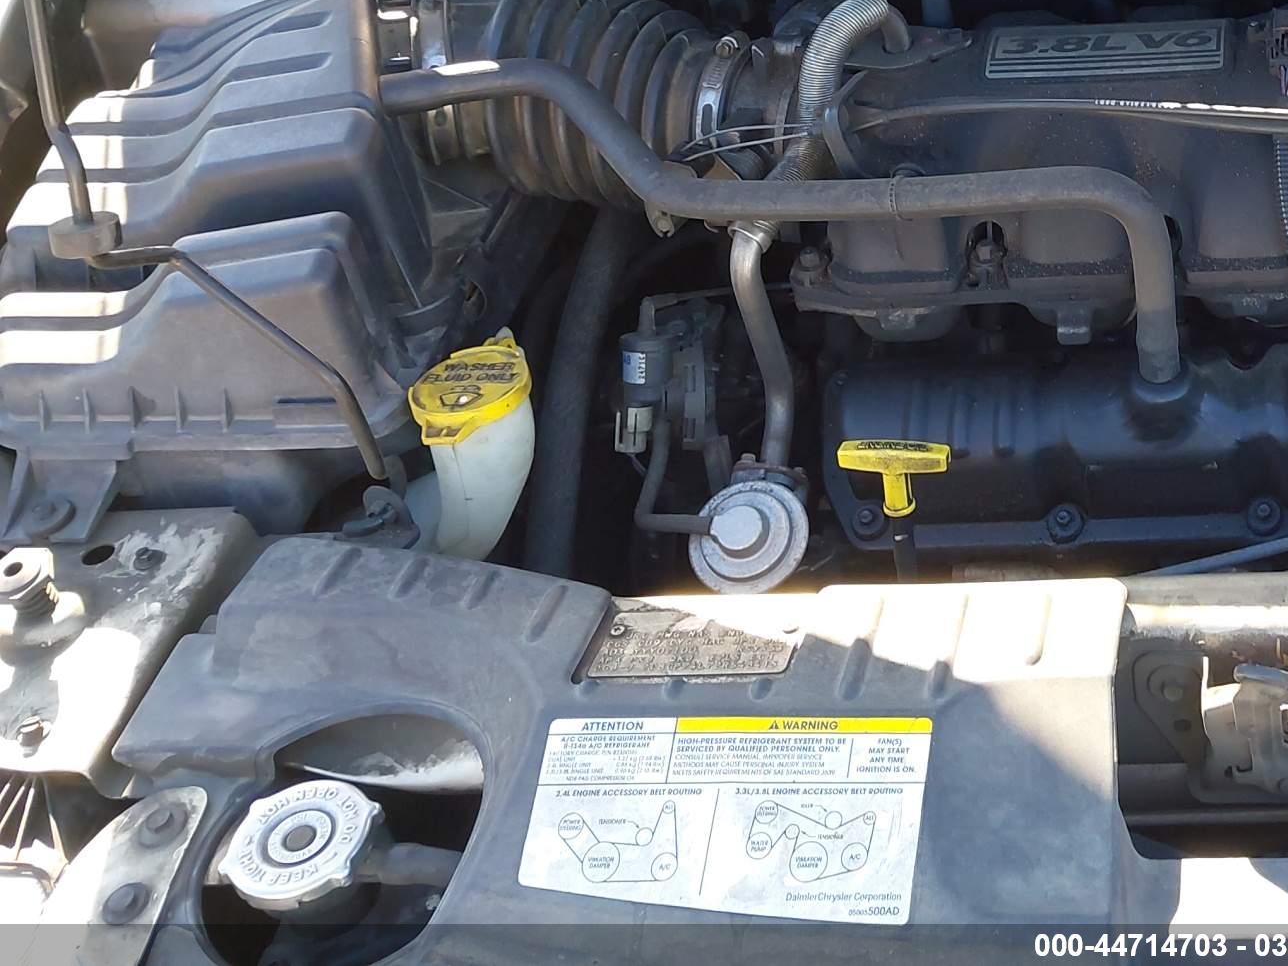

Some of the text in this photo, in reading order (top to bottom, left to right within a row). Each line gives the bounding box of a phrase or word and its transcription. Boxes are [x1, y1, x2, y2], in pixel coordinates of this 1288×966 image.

[1002, 30, 1213, 55] 3.8L V6
[444, 361, 516, 372] WASHER
[423, 372, 521, 384] FLUID ONLY
[582, 721, 645, 731] ATTENTION
[782, 720, 839, 731] WARNING
[678, 737, 738, 745] HIGH-PRESSURE
[739, 737, 792, 745] REFRIGERANT
[793, 737, 824, 745] SYSTEM
[878, 737, 903, 747] FAN(S)
[676, 745, 841, 753] SERVICED BY QUALIFIED PERSONNEL ONLY.
[886, 746, 910, 754] START
[869, 755, 904, 764] ANY TIME
[855, 765, 892, 773] IGNITION
[892, 765, 901, 773] IS
[572, 789, 601, 797] ENGINE
[602, 788, 649, 796] ACCESSORY
[649, 788, 667, 796] BELT
[771, 787, 801, 795] ENGINE
[802, 787, 849, 795] ACCESSORY
[850, 787, 867, 795] BELT
[867, 787, 904, 795] ROUTING
[658, 863, 671, 871] A/C
[785, 892, 902, 904] DaimlerChrysler Corporation
